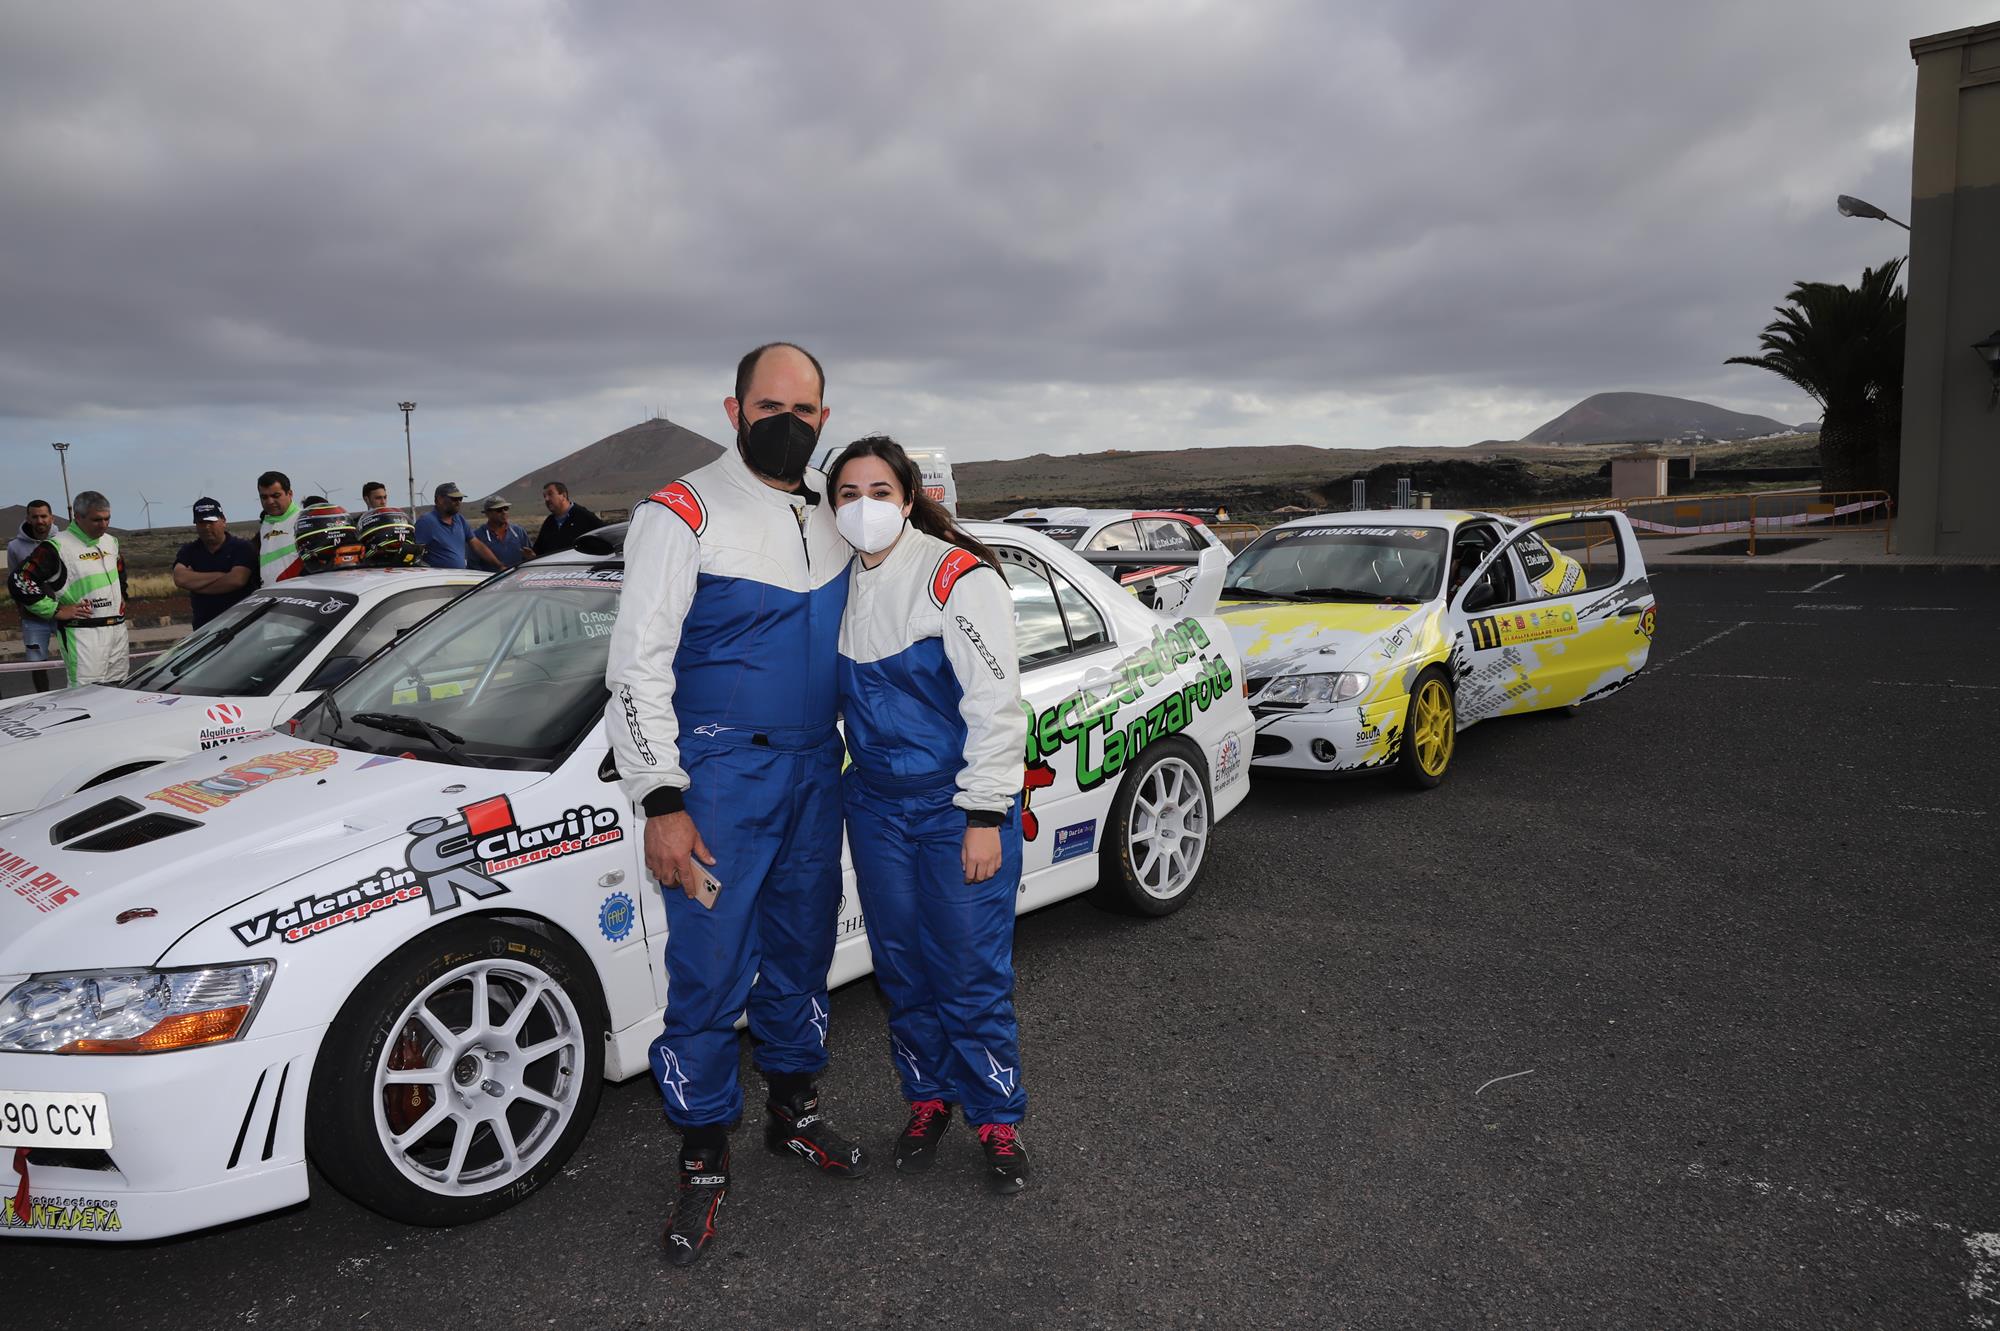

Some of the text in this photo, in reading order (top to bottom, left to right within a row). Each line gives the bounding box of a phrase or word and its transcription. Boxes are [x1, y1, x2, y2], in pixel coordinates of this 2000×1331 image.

[1297, 528, 1398, 538] AUTOESCUELA
[1472, 618, 1497, 649] 11
[200, 726, 246, 739] Alquileres
[1076, 653, 1234, 793] Lanzarote
[475, 806, 616, 860] Clavijo
[486, 838, 582, 876] lanzarote
[237, 870, 417, 944] Valentin
[285, 885, 424, 941] transporte
[0, 1102, 97, 1136] 90 CCY
[28, 1195, 118, 1208] otulaciones
